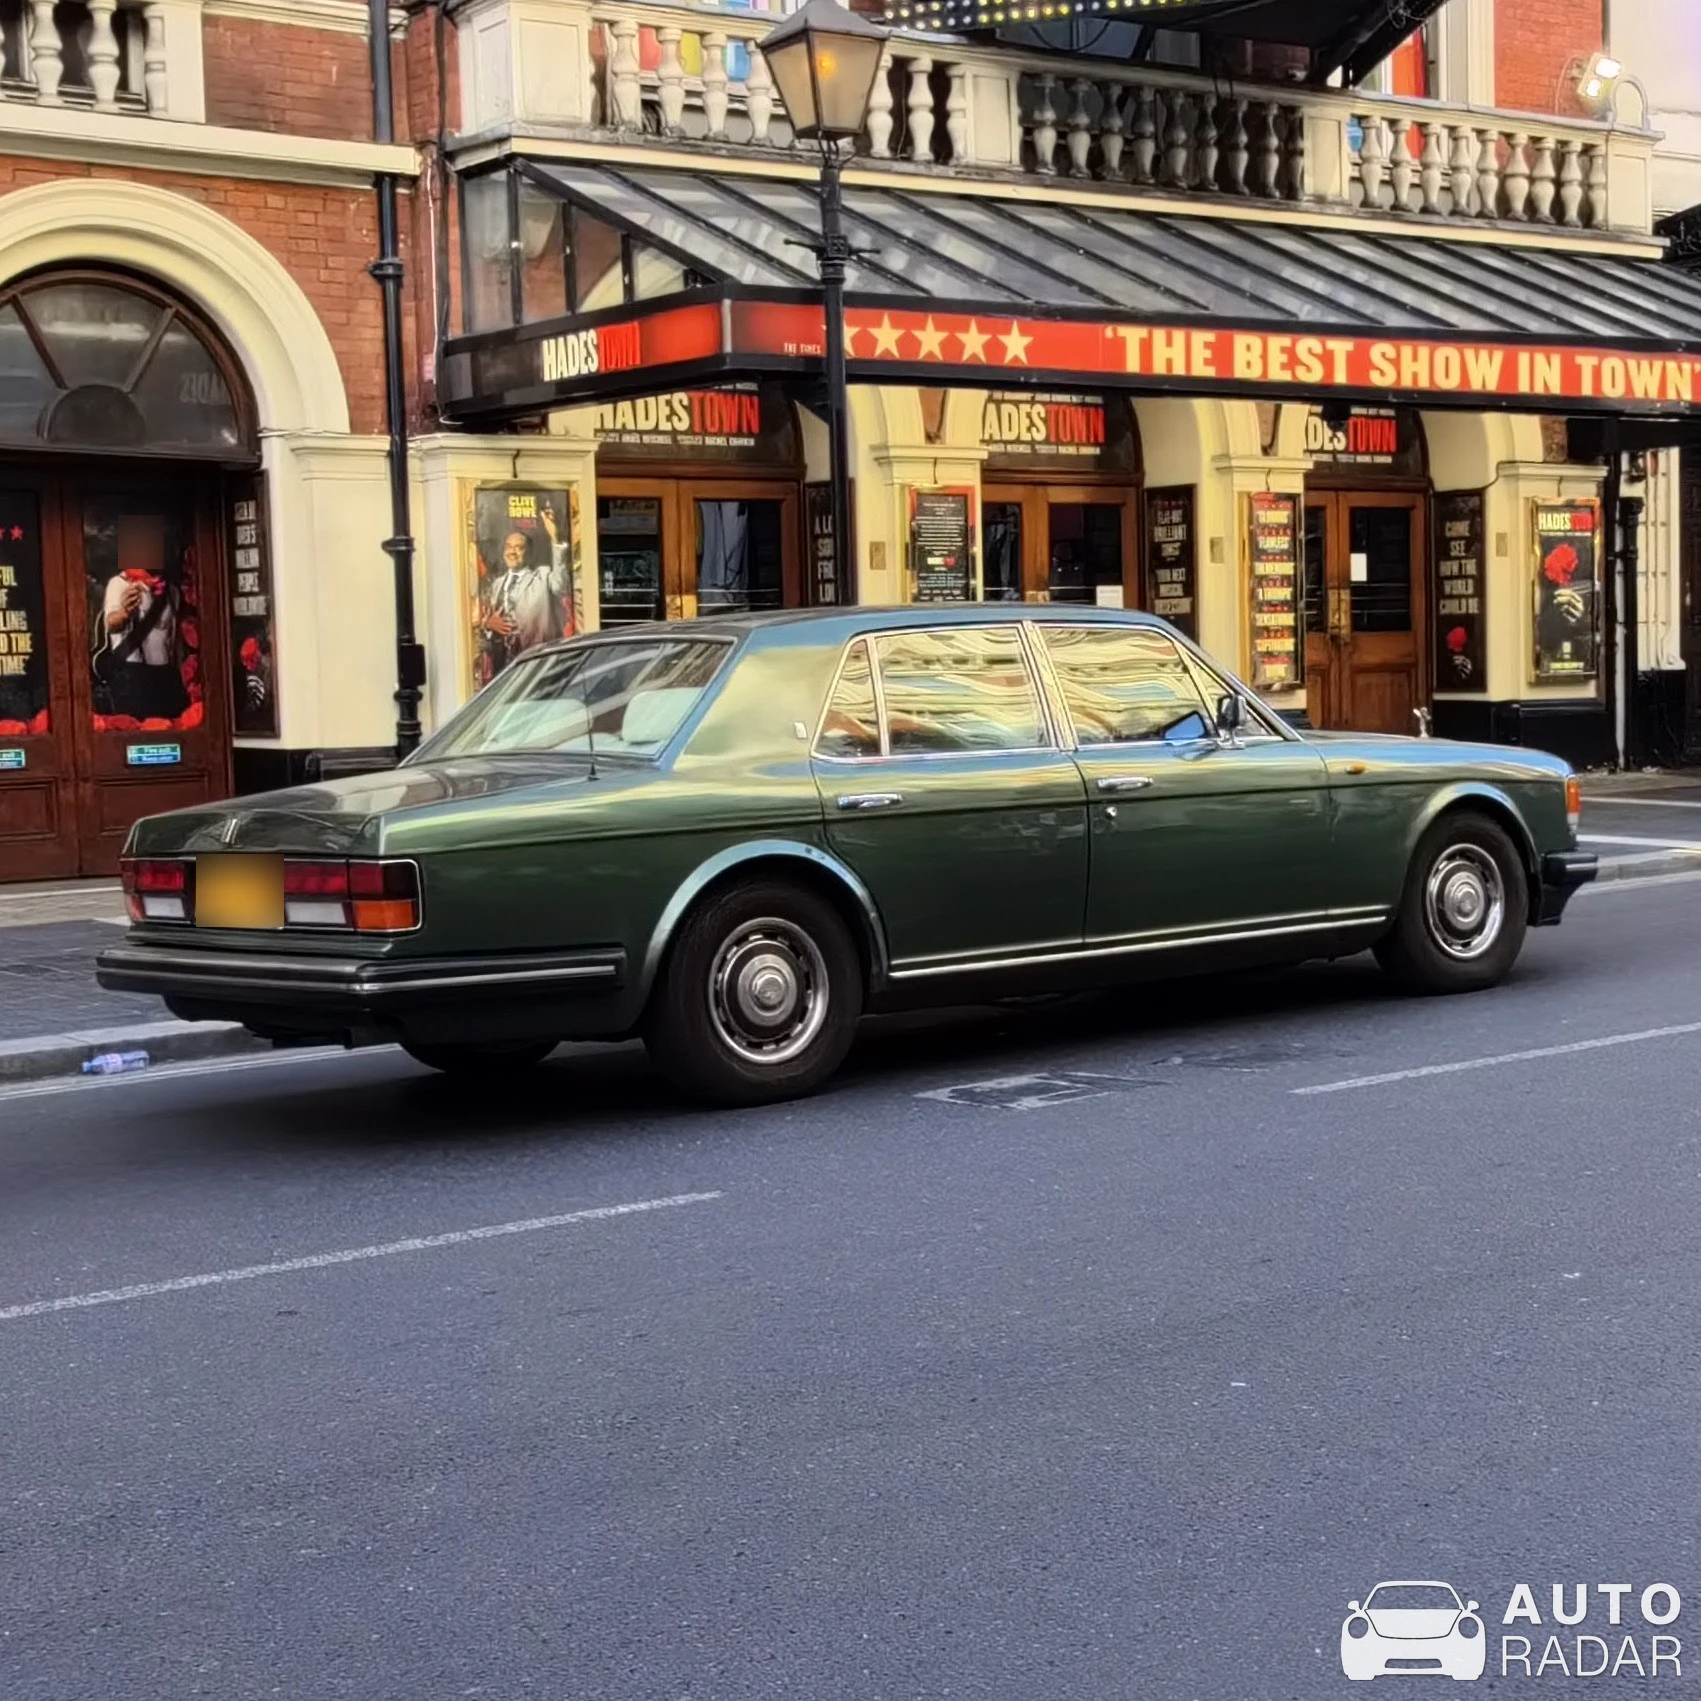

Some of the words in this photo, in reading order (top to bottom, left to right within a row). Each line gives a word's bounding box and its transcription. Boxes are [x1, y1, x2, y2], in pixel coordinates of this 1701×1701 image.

[1234, 334, 1354, 383] BEST
[1369, 343, 1503, 391] SHOW
[1518, 352, 1561, 395] IN
[983, 403, 1105, 443] ADESTOWN
